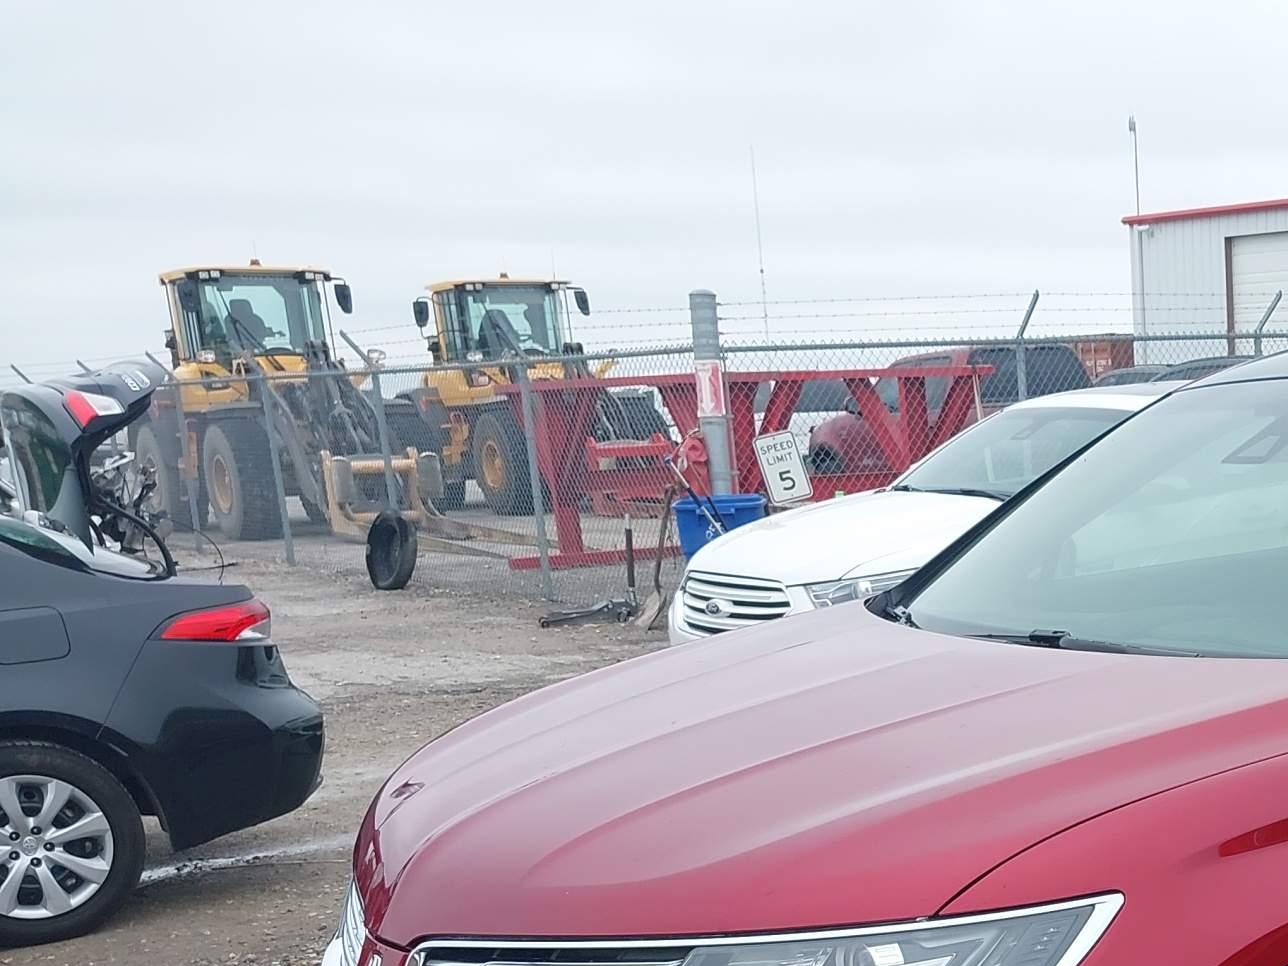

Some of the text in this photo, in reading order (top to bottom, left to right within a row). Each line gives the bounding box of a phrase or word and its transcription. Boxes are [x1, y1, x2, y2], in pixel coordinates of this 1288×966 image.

[761, 440, 793, 455] SPEED
[766, 452, 793, 465] LIMIT
[779, 470, 796, 490] 5
